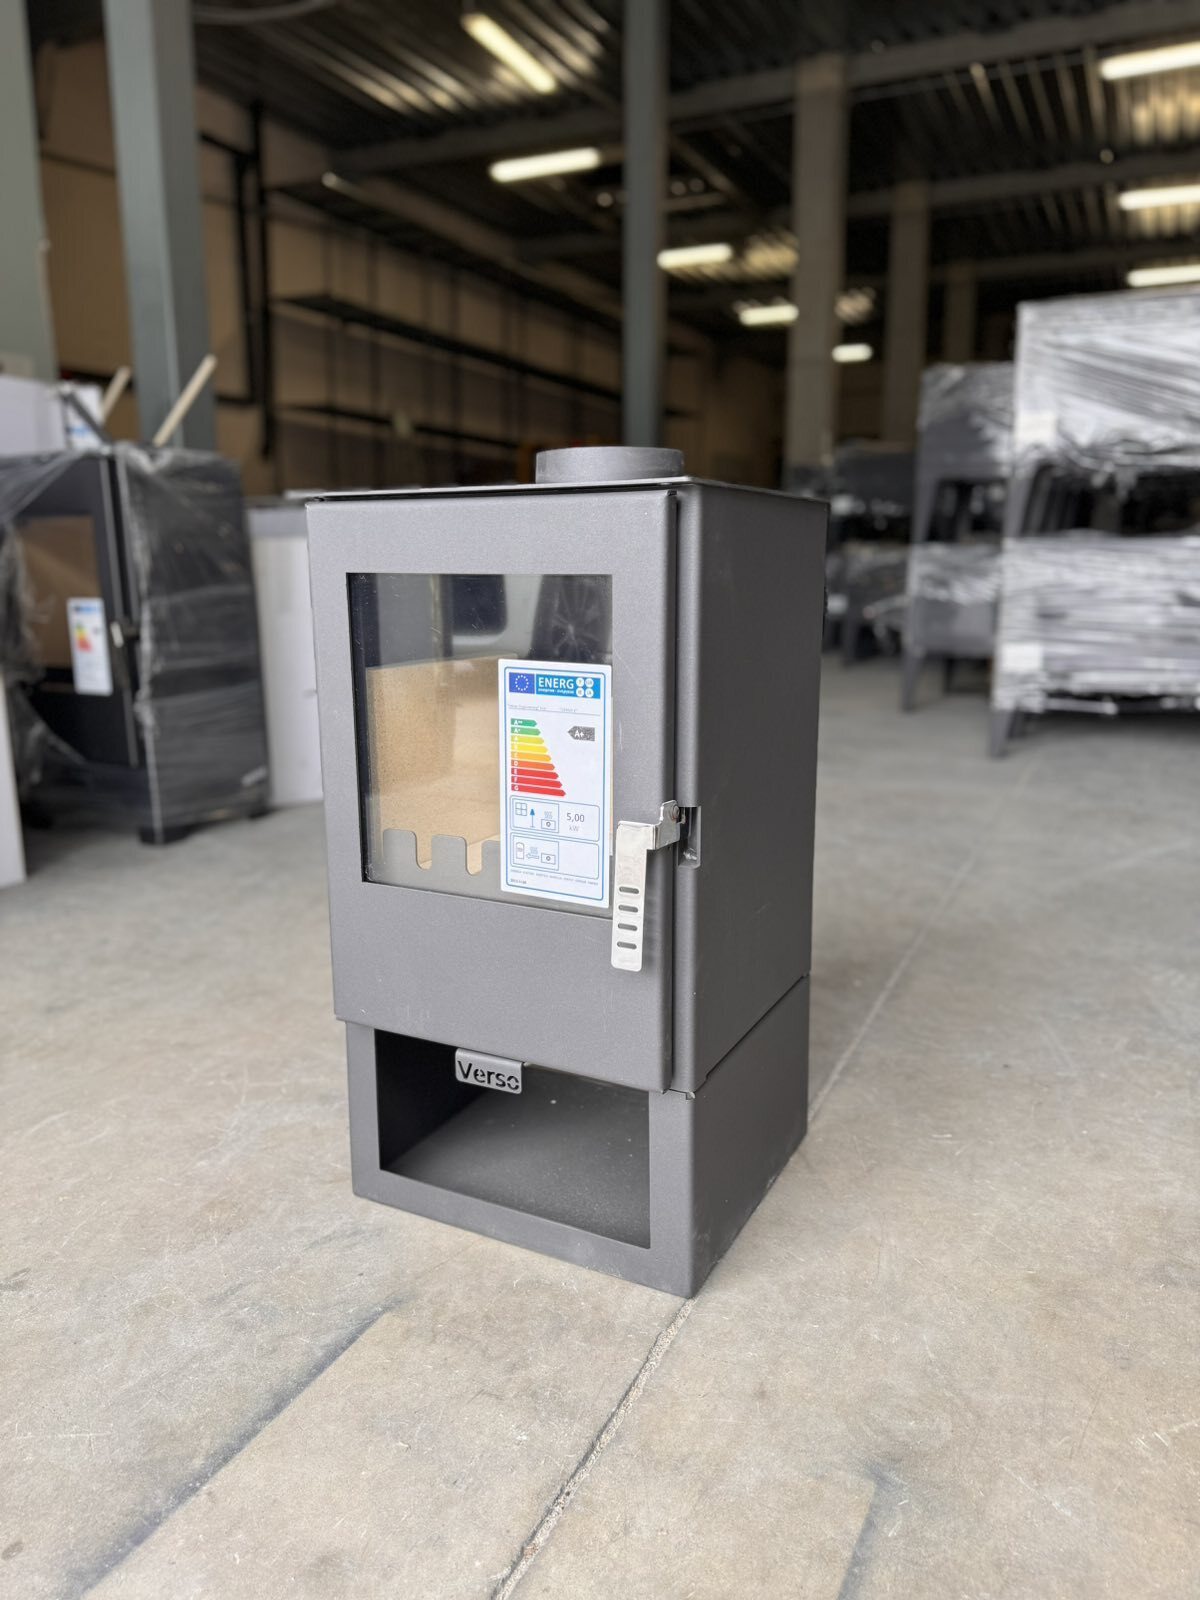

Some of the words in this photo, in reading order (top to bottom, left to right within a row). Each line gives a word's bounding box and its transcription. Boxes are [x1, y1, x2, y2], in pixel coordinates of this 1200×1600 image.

[538, 677, 574, 690] ENERG
[574, 729, 585, 738] A+
[566, 812, 585, 823] 5,00
[457, 1060, 519, 1091] Verso
